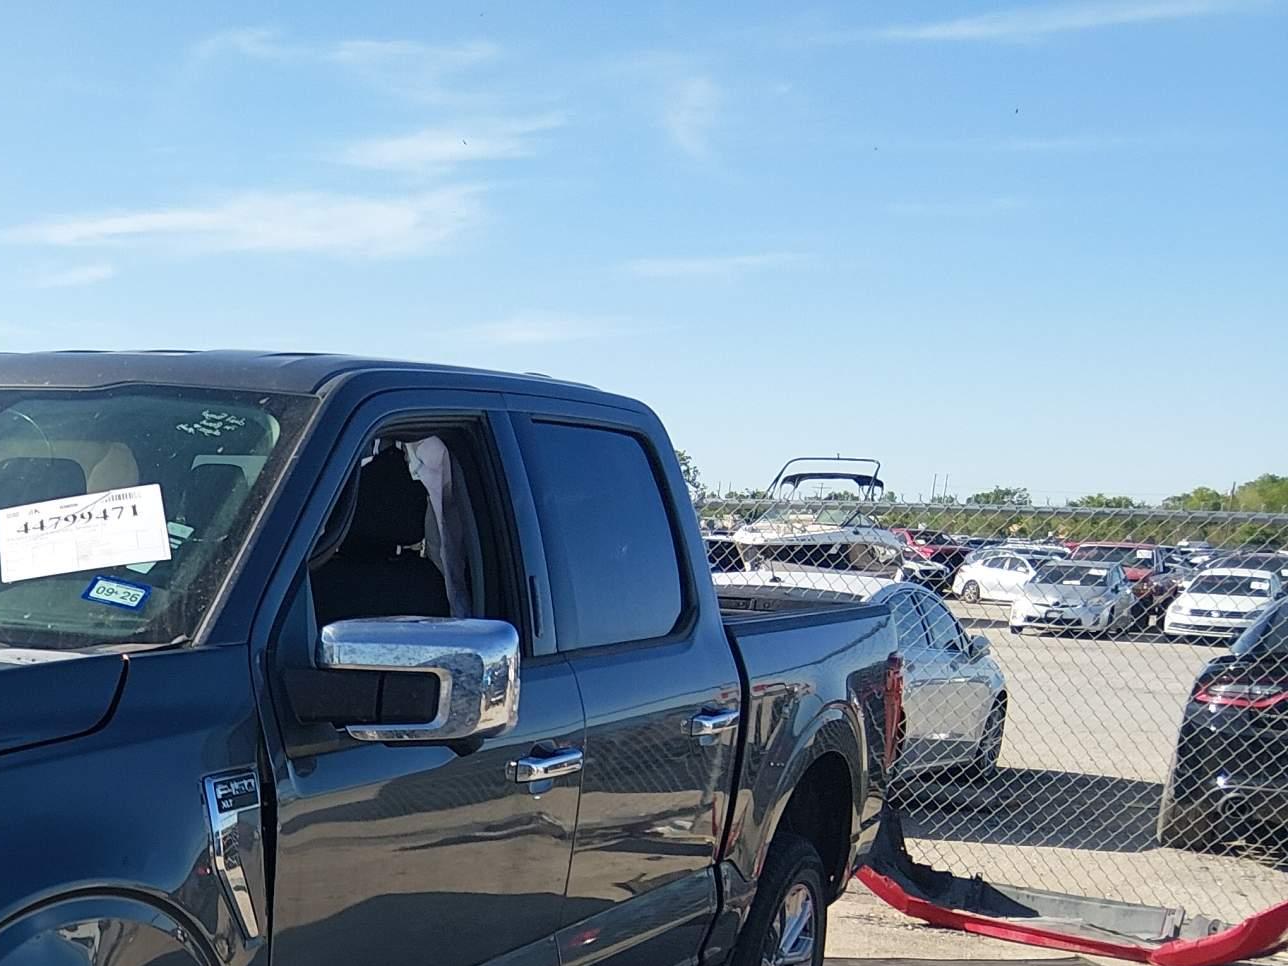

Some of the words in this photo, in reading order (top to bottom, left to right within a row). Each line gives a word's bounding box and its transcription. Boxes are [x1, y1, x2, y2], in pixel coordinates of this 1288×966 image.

[16, 503, 139, 534] 44799471
[95, 585, 115, 597] 09
[119, 591, 141, 603] 26
